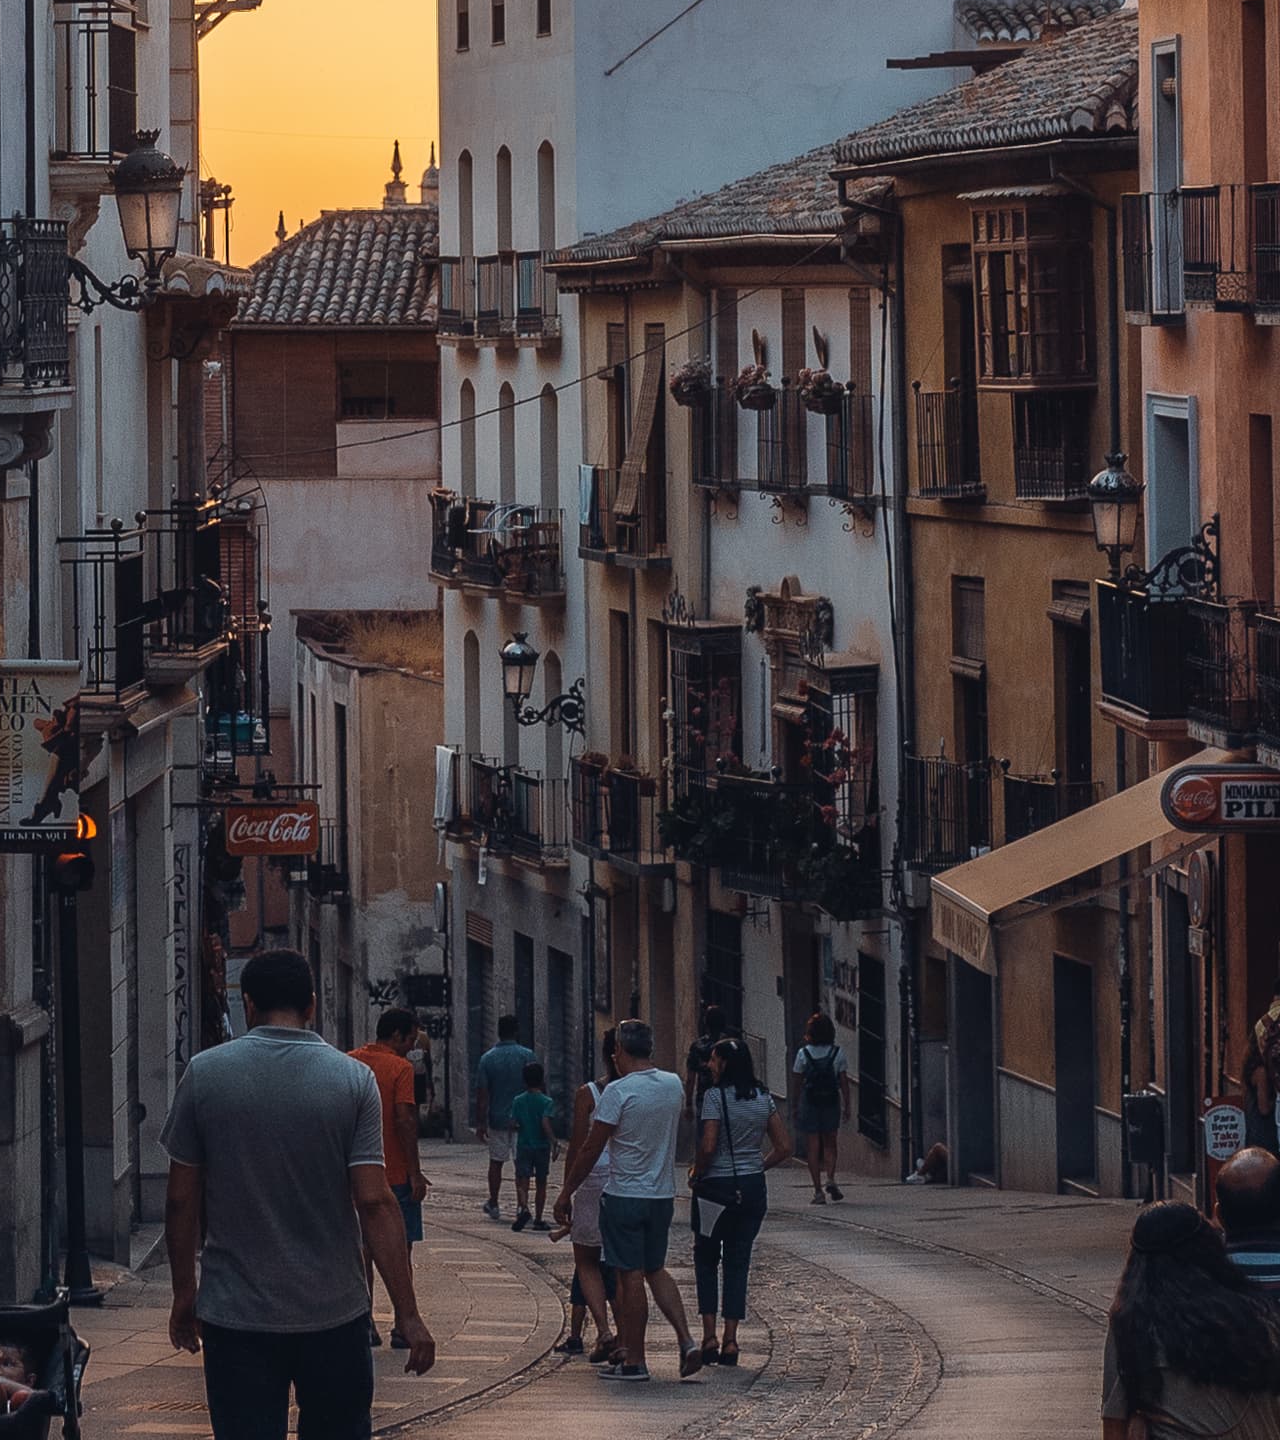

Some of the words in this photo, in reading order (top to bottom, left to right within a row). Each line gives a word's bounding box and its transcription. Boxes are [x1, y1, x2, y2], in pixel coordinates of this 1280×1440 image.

[12, 734, 24, 804] FLAMENCO
[4, 831, 42, 841] TICKETS
[1212, 1132, 1239, 1140] Take
[1212, 1141, 1240, 1150] away
